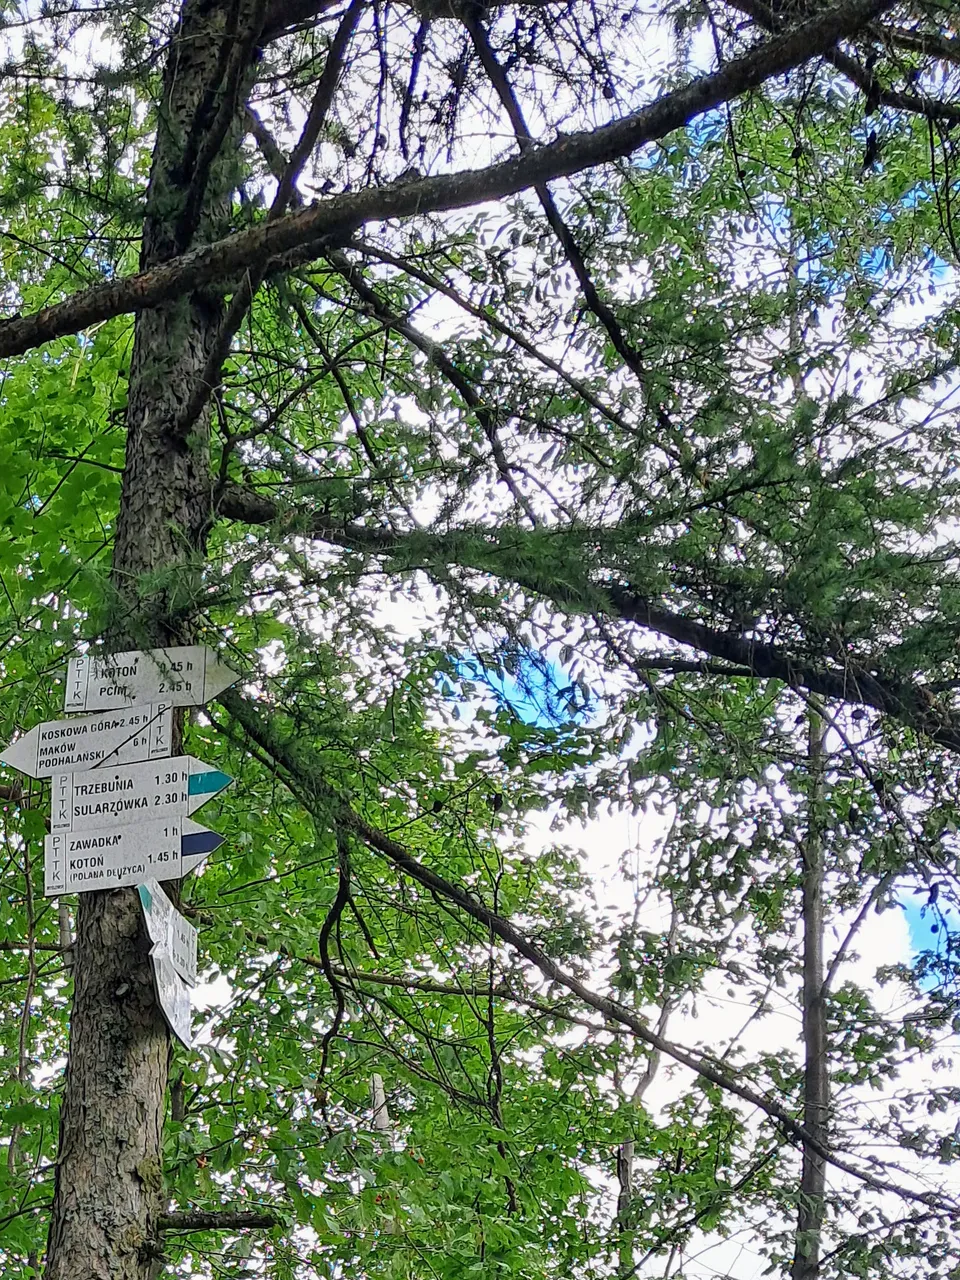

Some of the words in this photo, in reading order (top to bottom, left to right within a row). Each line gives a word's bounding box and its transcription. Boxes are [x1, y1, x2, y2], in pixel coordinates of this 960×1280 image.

[73, 659, 84, 700] PTTK
[159, 681, 182, 693] 2.45
[41, 725, 88, 741] KOSKOWA
[90, 720, 118, 733] GÓRA
[119, 715, 140, 727] 2.45
[142, 714, 149, 723] h
[39, 750, 105, 769] PODHALAŃSKI
[40, 741, 76, 757] MAKÓW
[133, 737, 139, 747] 6
[141, 737, 147, 746] h
[74, 779, 134, 797] TRZEBUNIA
[154, 772, 178, 786] 1.30
[181, 771, 188, 782] h
[58, 775, 68, 820] PTTK
[74, 797, 149, 817] SULARZÓWKA
[154, 792, 178, 806] 2.30
[181, 791, 188, 802] h
[69, 835, 119, 852] ZAWADKA
[163, 827, 169, 837] 1
[172, 825, 179, 837] h
[52, 836, 61, 881] PTTK
[69, 854, 104, 870] KOTOŃ
[147, 851, 170, 864] 1.45
[172, 850, 179, 860] h
[69, 869, 104, 883] (POLANA
